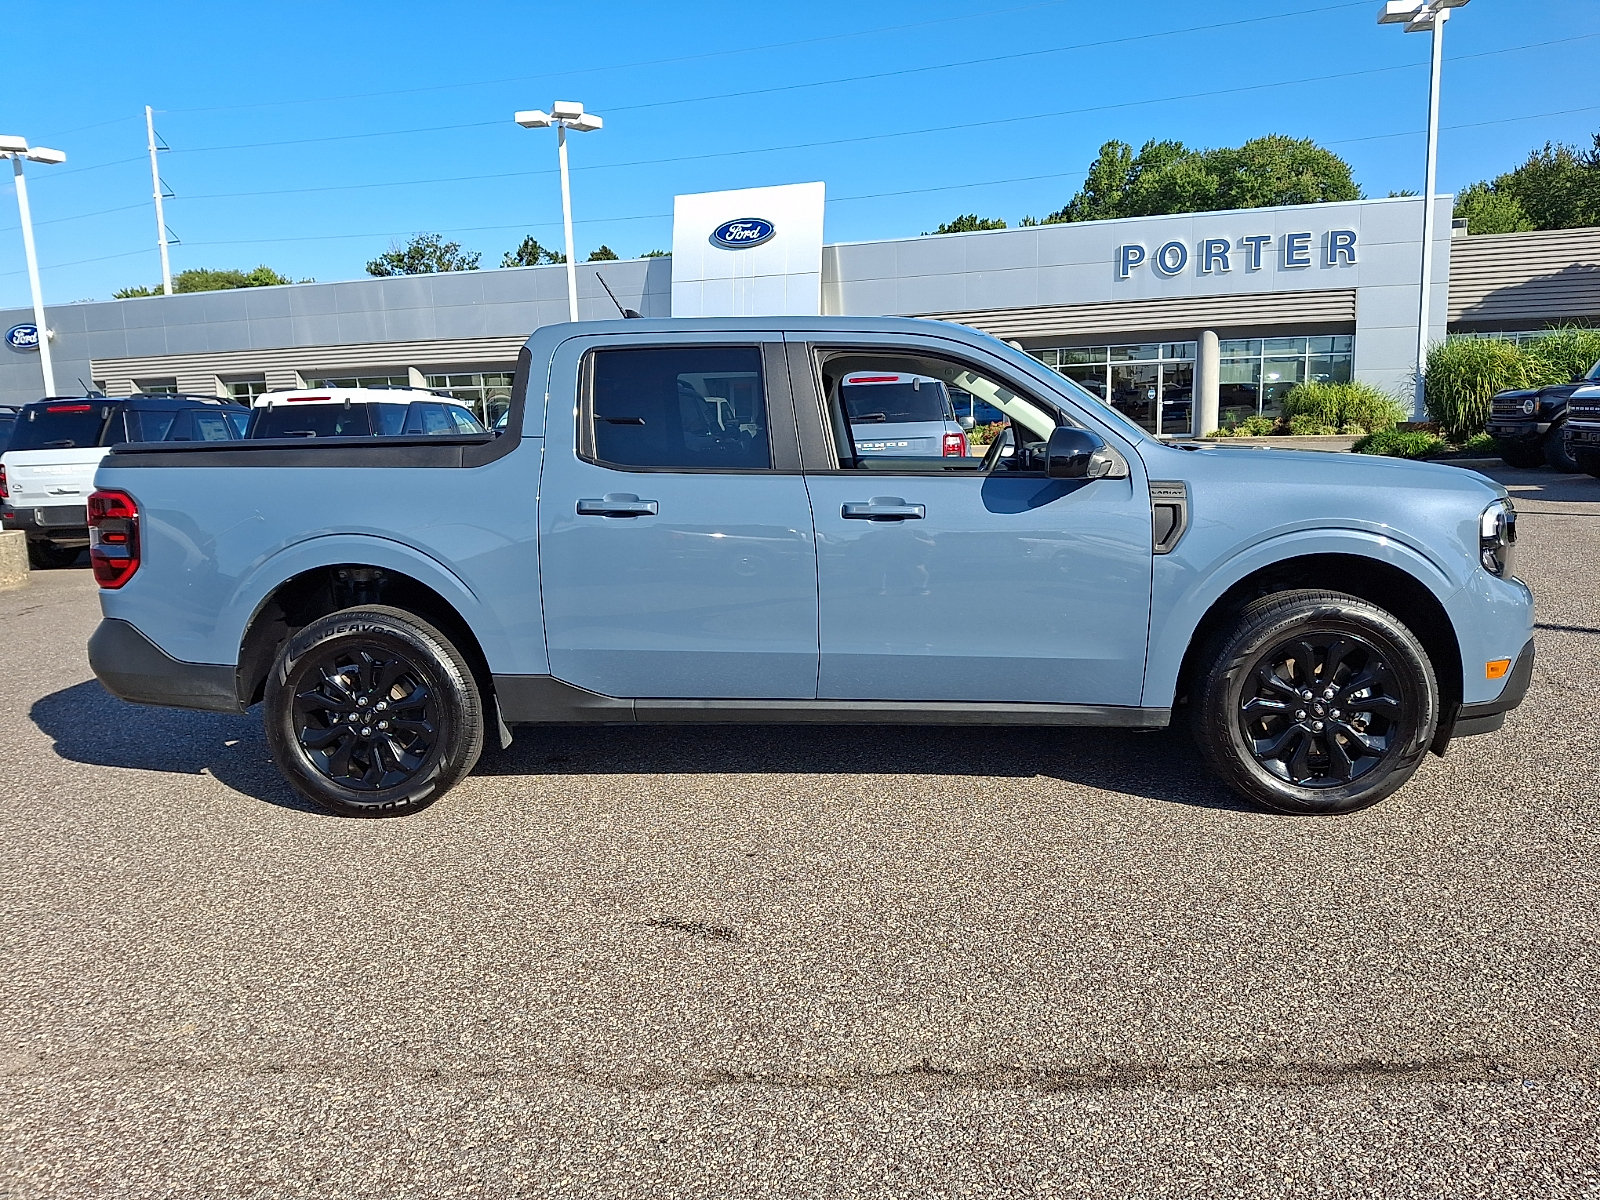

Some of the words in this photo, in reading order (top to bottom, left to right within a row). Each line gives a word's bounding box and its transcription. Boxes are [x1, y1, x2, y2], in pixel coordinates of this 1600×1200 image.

[725, 223, 761, 241] Ford
[1119, 229, 1358, 278] PORTER
[12, 328, 38, 344] Ford
